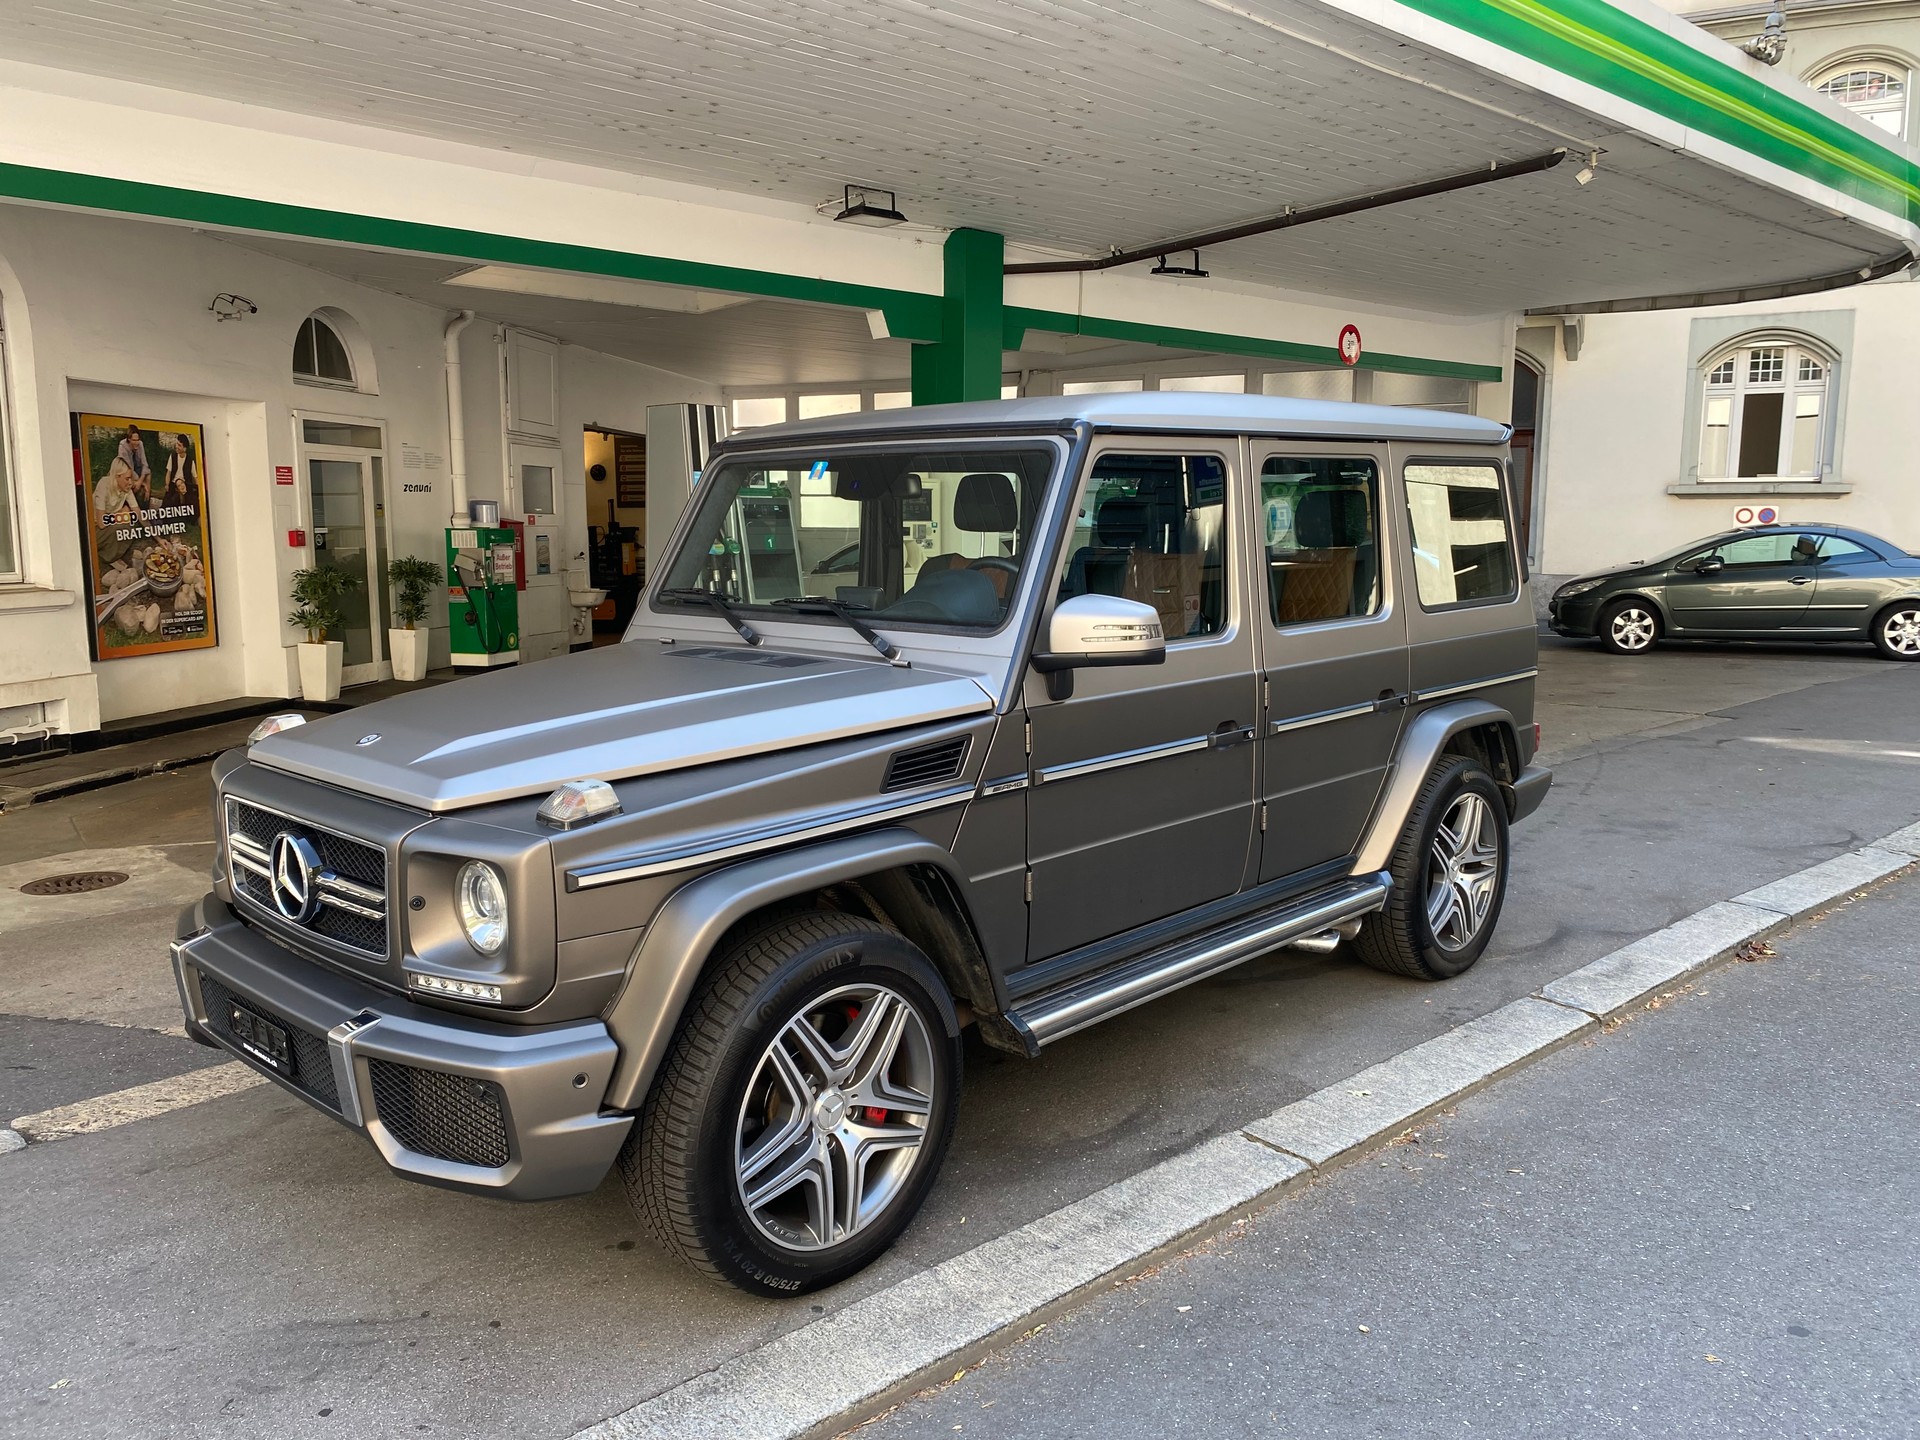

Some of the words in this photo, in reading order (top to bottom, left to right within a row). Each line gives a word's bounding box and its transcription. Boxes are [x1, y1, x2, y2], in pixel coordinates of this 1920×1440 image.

[403, 482, 432, 493] zenuni
[102, 511, 138, 527] scoop
[141, 509, 157, 521] DIR
[159, 505, 195, 519] DEINEN
[116, 527, 142, 541] BRAT
[144, 522, 187, 537] SUMMER
[767, 538, 774, 548] 1
[496, 553, 511, 561] Außer
[1002, 781, 1024, 791] AMG
[732, 1253, 742, 1263] V
[741, 1260, 756, 1274] 20
[754, 1270, 765, 1280] R
[764, 1274, 802, 1291] 275/50
